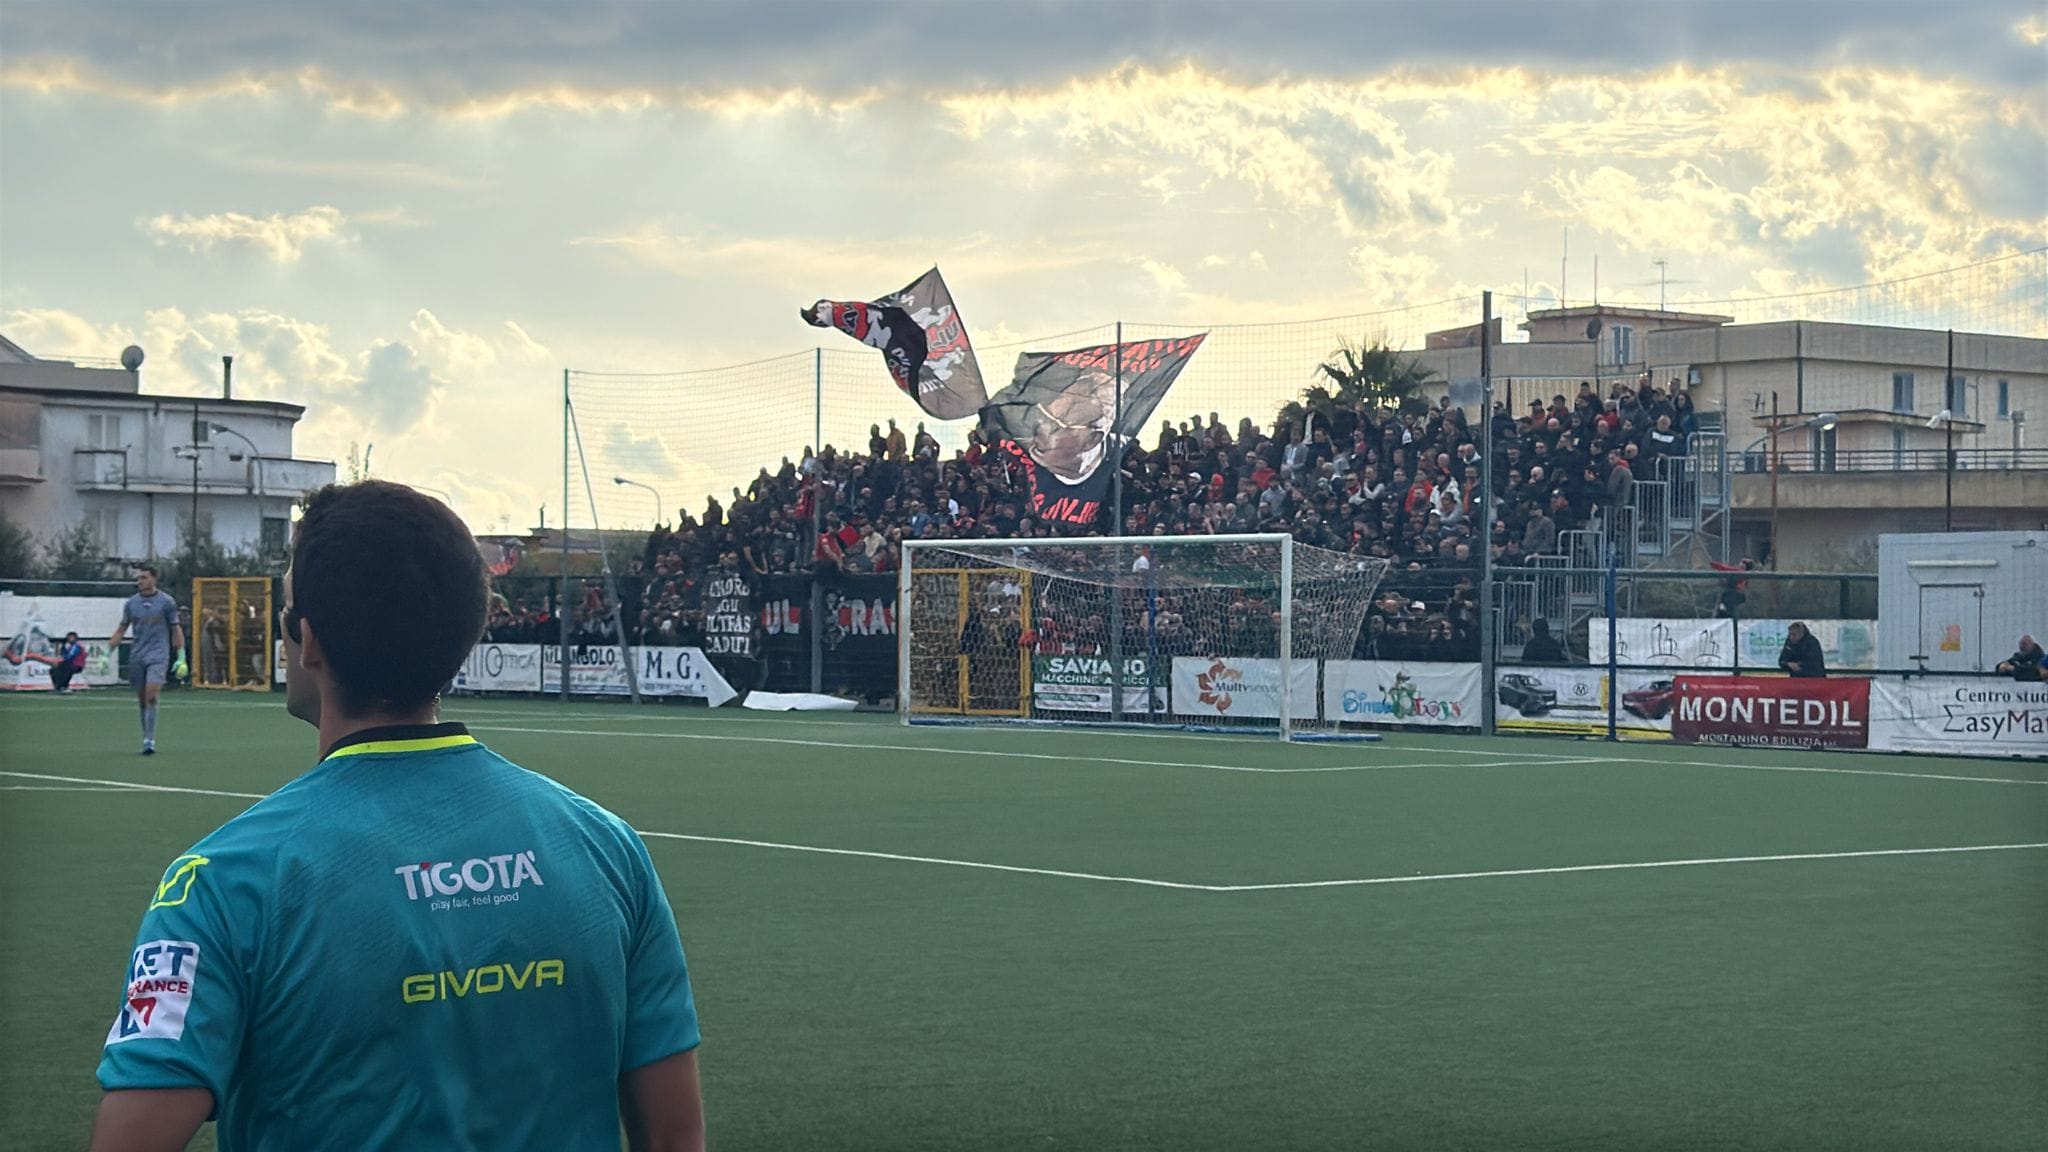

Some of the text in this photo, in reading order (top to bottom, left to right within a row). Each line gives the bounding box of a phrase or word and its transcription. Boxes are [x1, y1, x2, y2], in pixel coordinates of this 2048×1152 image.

[1955, 688, 2011, 703] Centro
[1679, 696, 1862, 727] MONTEDIL
[1699, 733, 1769, 745] MONTANINO
[493, 892, 519, 905] good
[402, 959, 564, 1003] GIVOVA
